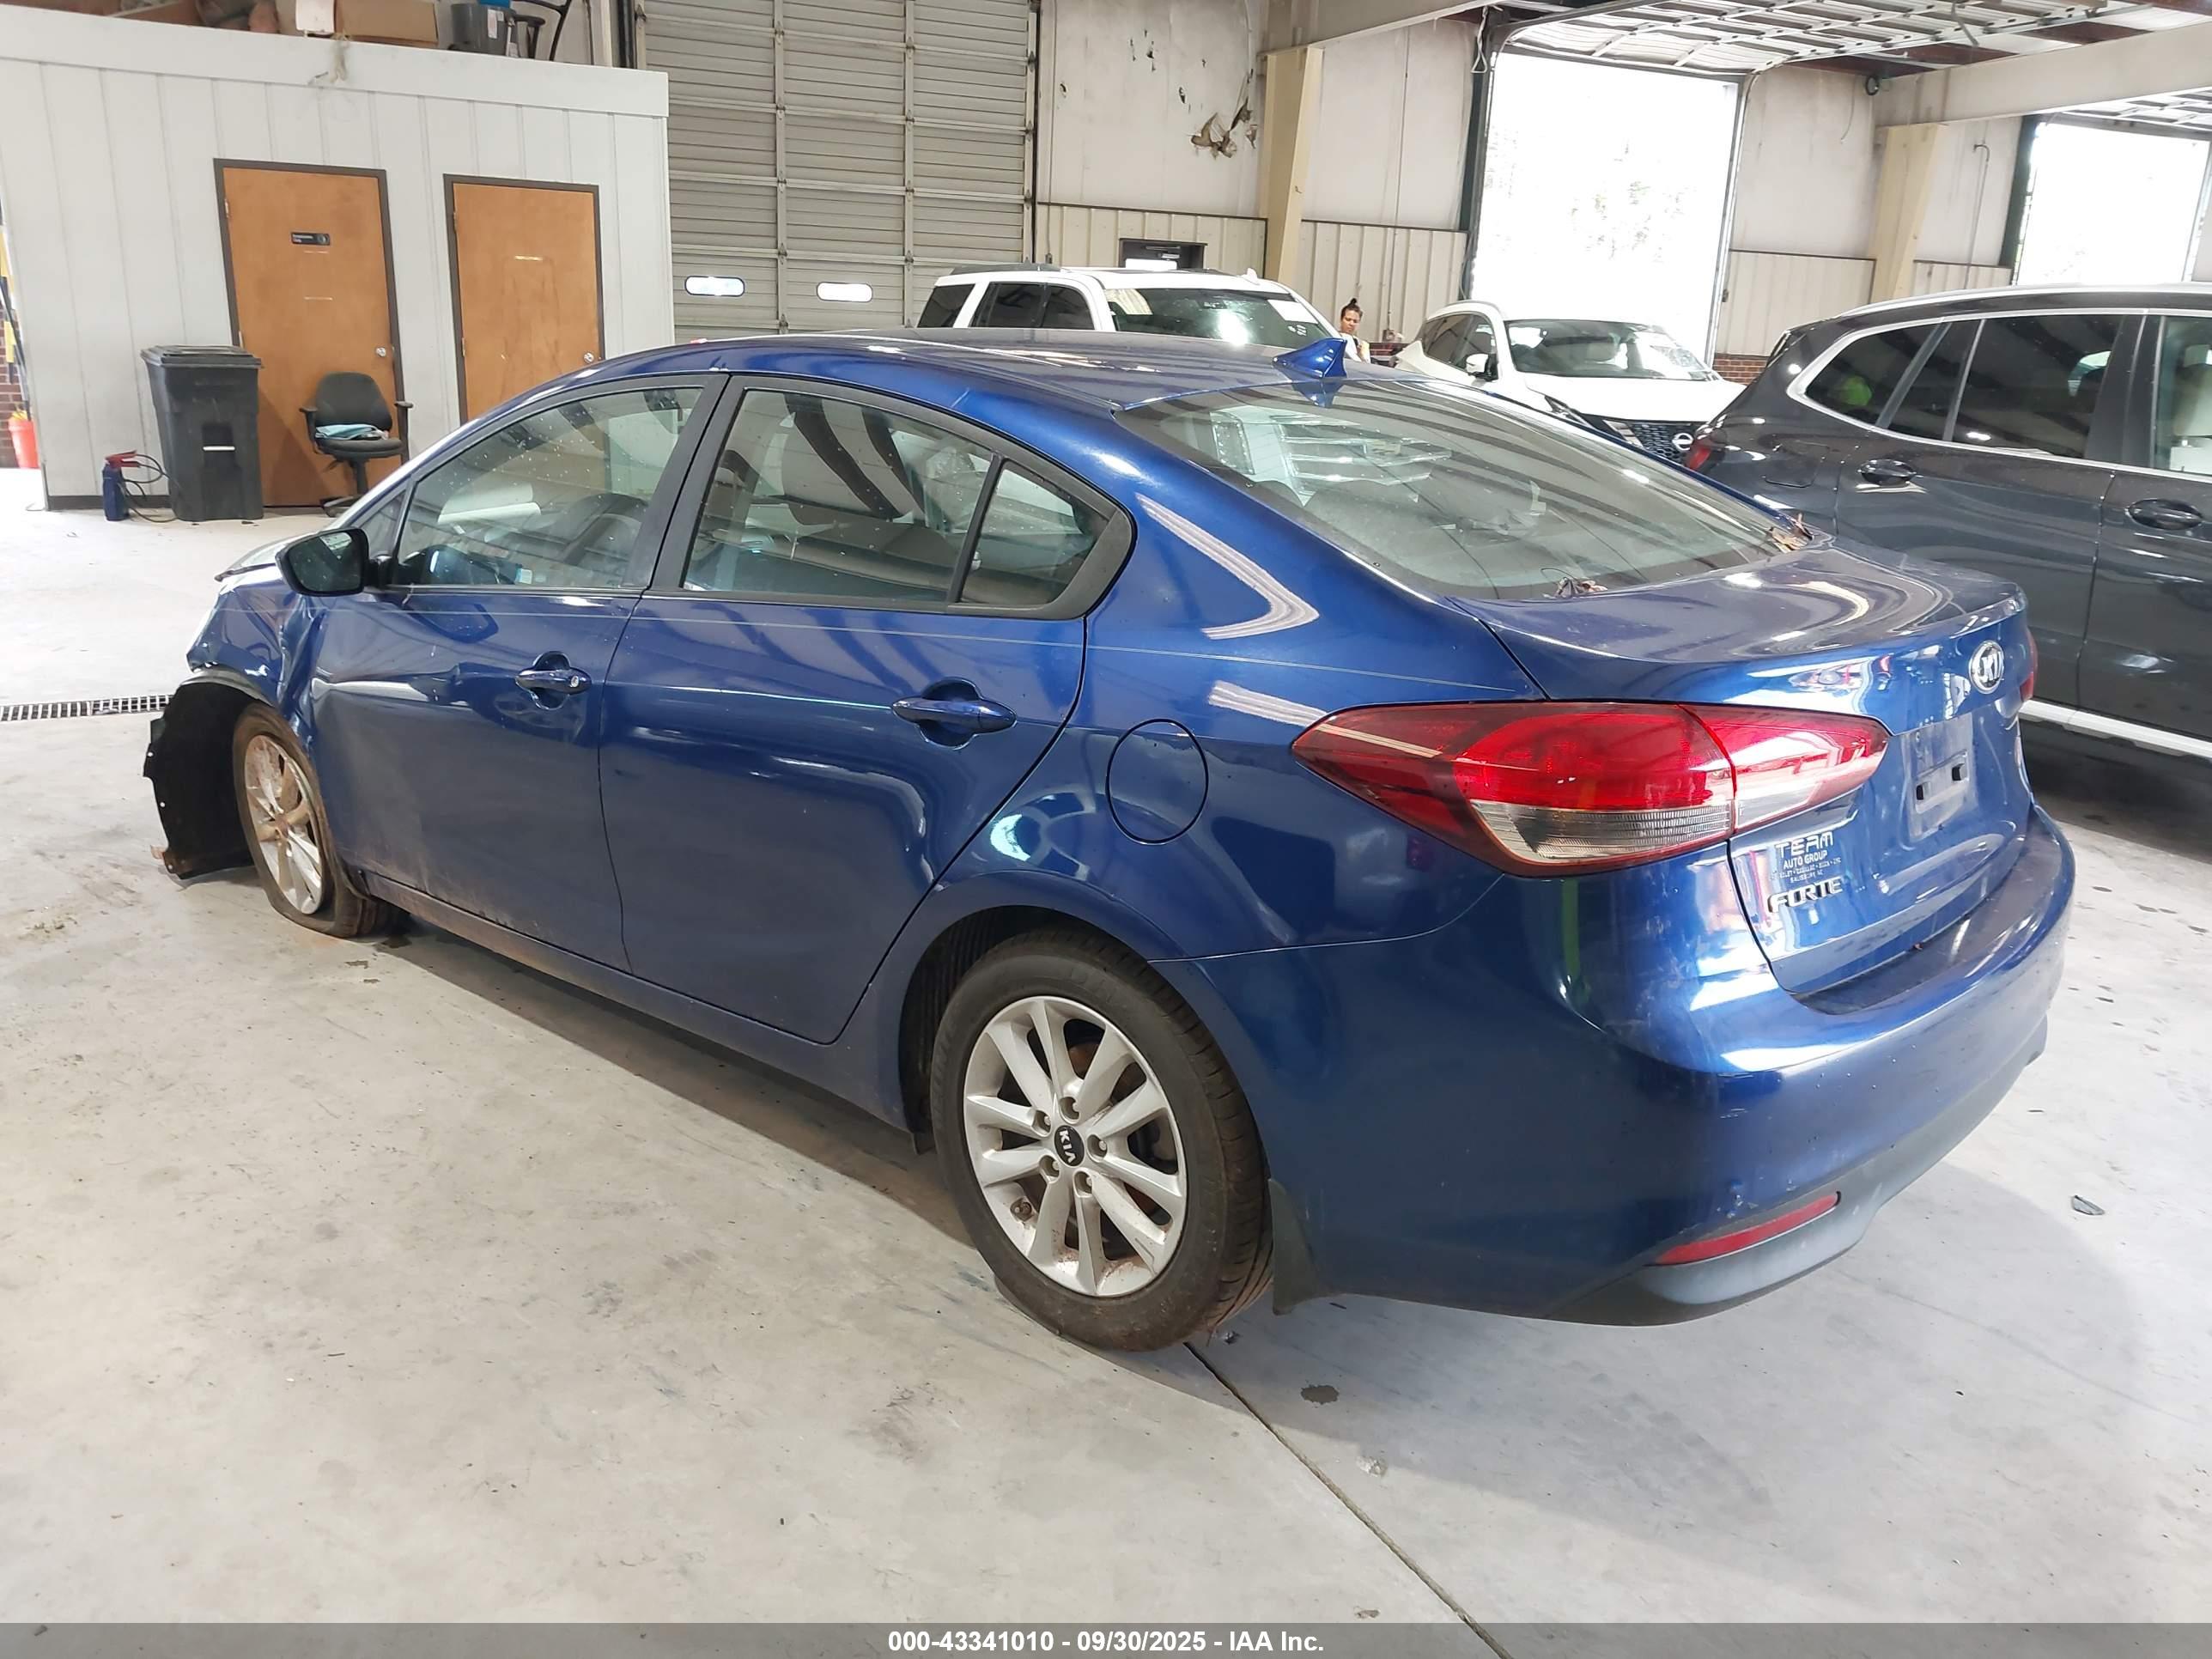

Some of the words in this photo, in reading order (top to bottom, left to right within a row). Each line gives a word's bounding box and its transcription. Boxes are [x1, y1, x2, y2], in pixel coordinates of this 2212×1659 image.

[1775, 831, 1833, 859] TEAM
[1784, 856, 1803, 870] AUTO
[1804, 849, 1828, 864] GROUP
[1769, 876, 1844, 913] FORTE
[1059, 1129, 1076, 1164] KIA
